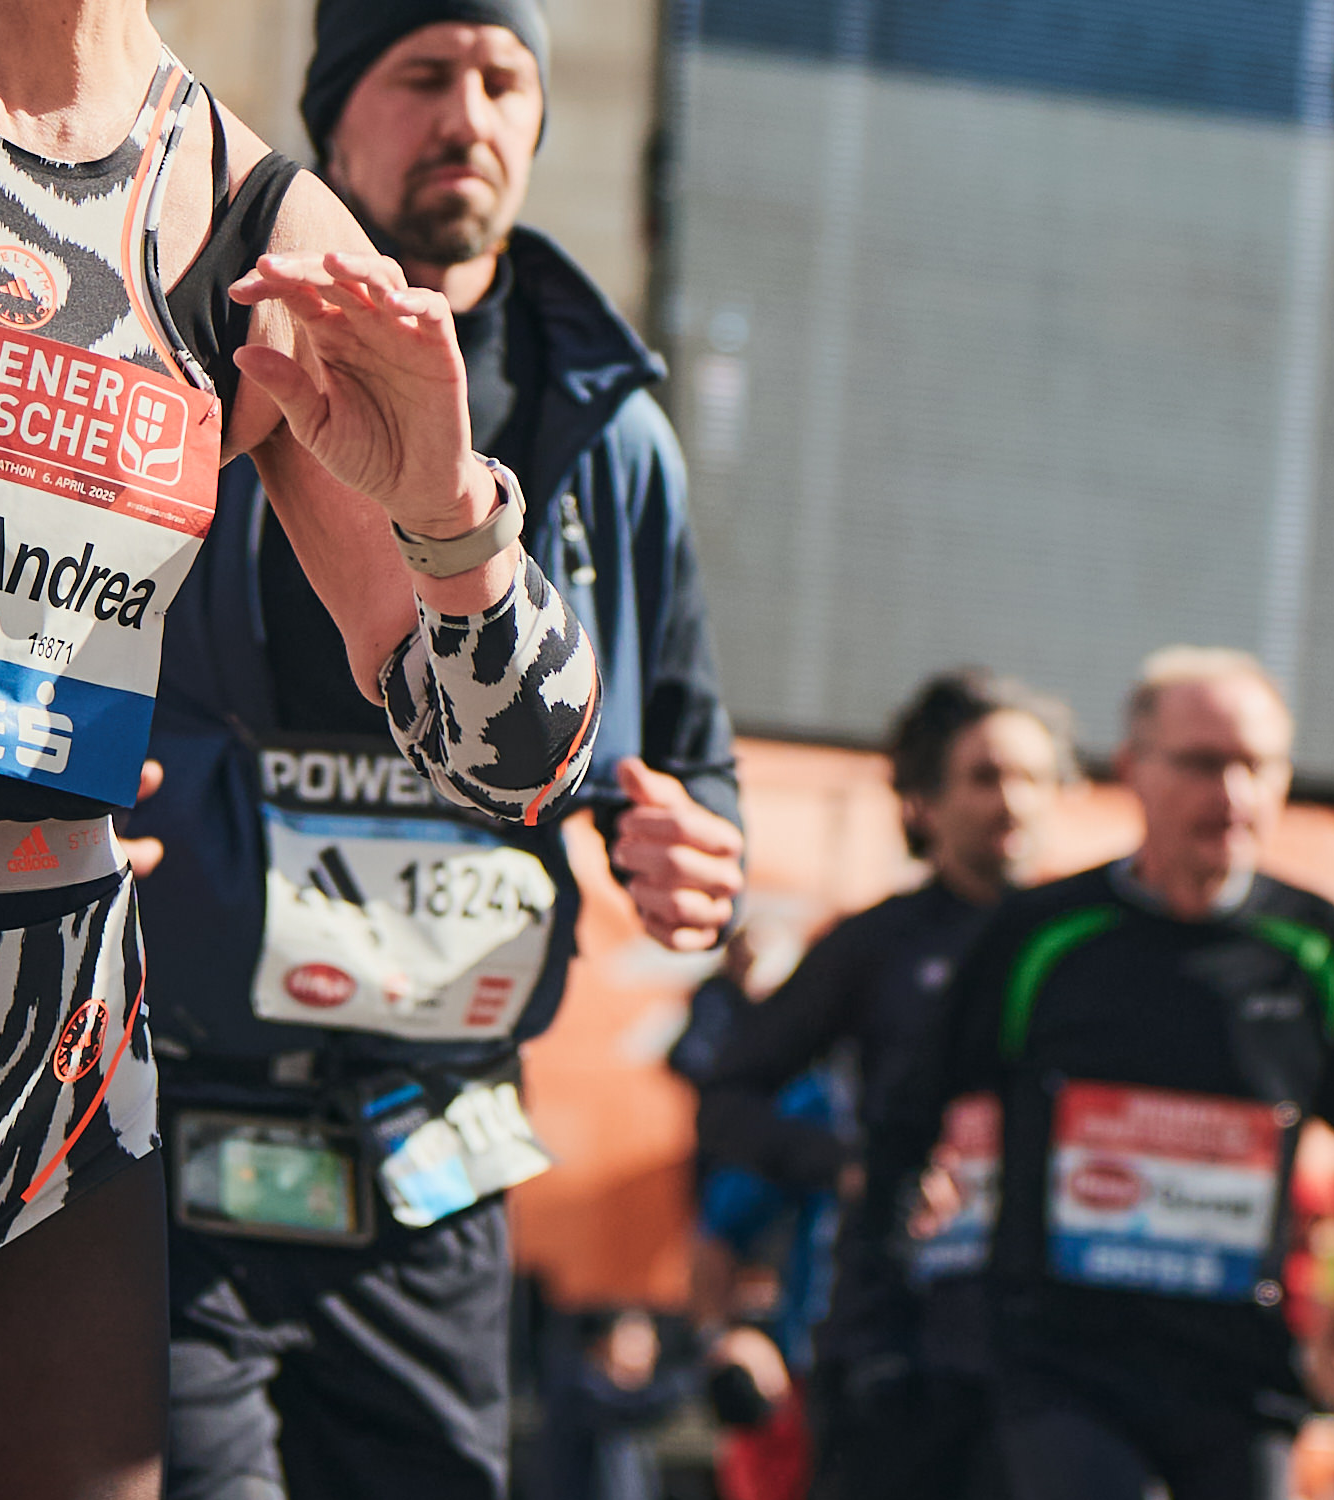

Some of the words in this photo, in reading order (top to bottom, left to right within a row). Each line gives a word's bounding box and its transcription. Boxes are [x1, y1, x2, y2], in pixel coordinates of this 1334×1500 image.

[42, 472, 53, 485] 6.
[55, 475, 86, 495] APRIL
[88, 485, 116, 503] 2025
[28, 633, 73, 665] 16871
[260, 750, 431, 804] POWE
[7, 854, 60, 873] adidas
